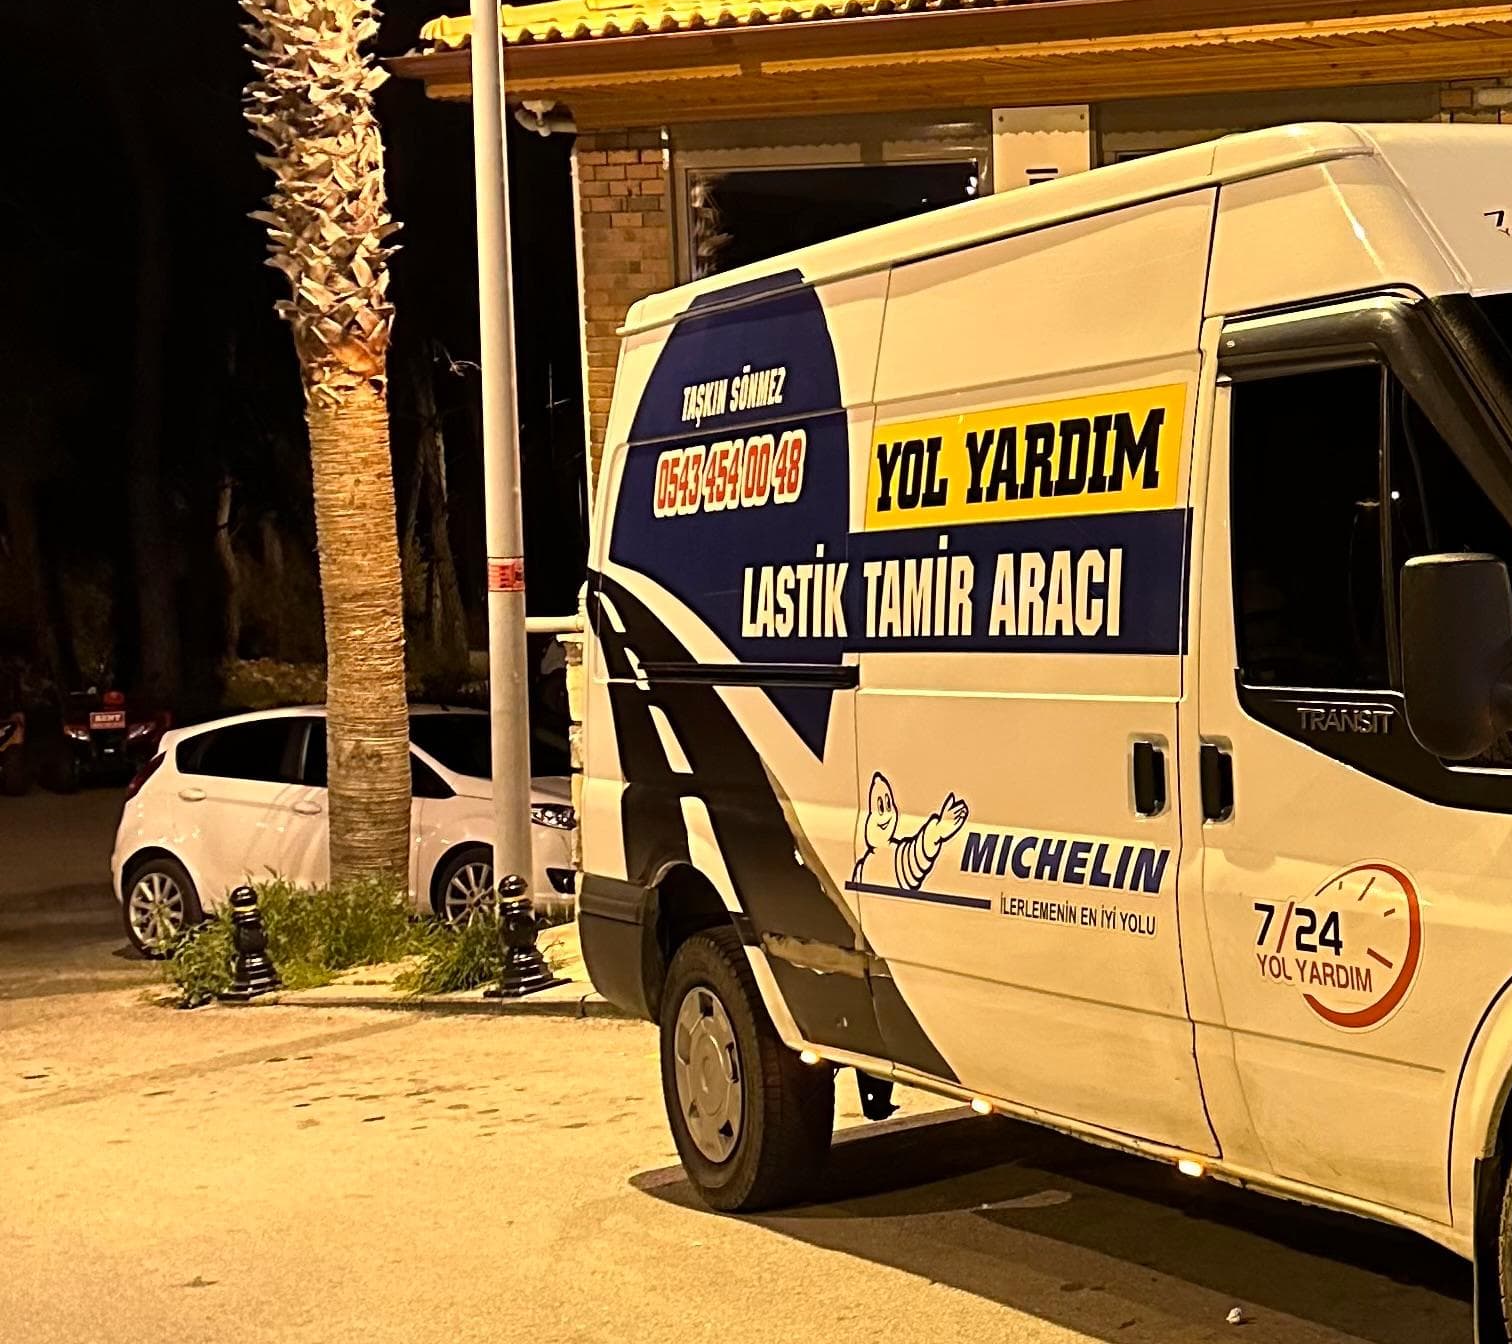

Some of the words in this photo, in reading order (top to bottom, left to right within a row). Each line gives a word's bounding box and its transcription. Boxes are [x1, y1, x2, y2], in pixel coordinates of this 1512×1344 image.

[681, 378, 729, 428] TAŞKIN
[729, 364, 786, 412] SÖNMEZ
[655, 451, 704, 512] 0543
[704, 446, 741, 505] 454
[743, 442, 772, 499] 00
[774, 436, 804, 496] 48
[876, 436, 948, 512] YOL
[965, 408, 1166, 504] YARDIM
[741, 543, 849, 638] LASTİK
[863, 534, 975, 637] TAMİR
[988, 547, 1123, 637] ARACI
[1296, 707, 1394, 734] TRANSIT
[960, 831, 1171, 894] MICHELIN
[1000, 891, 1077, 924] İLERLEMENİN
[1080, 906, 1097, 927] EN
[1100, 904, 1117, 930] İYİ
[1119, 912, 1156, 936] YOLU
[1254, 901, 1343, 957] 7/24
[1256, 953, 1292, 981] YOL
[1295, 958, 1373, 993] YARDIM
